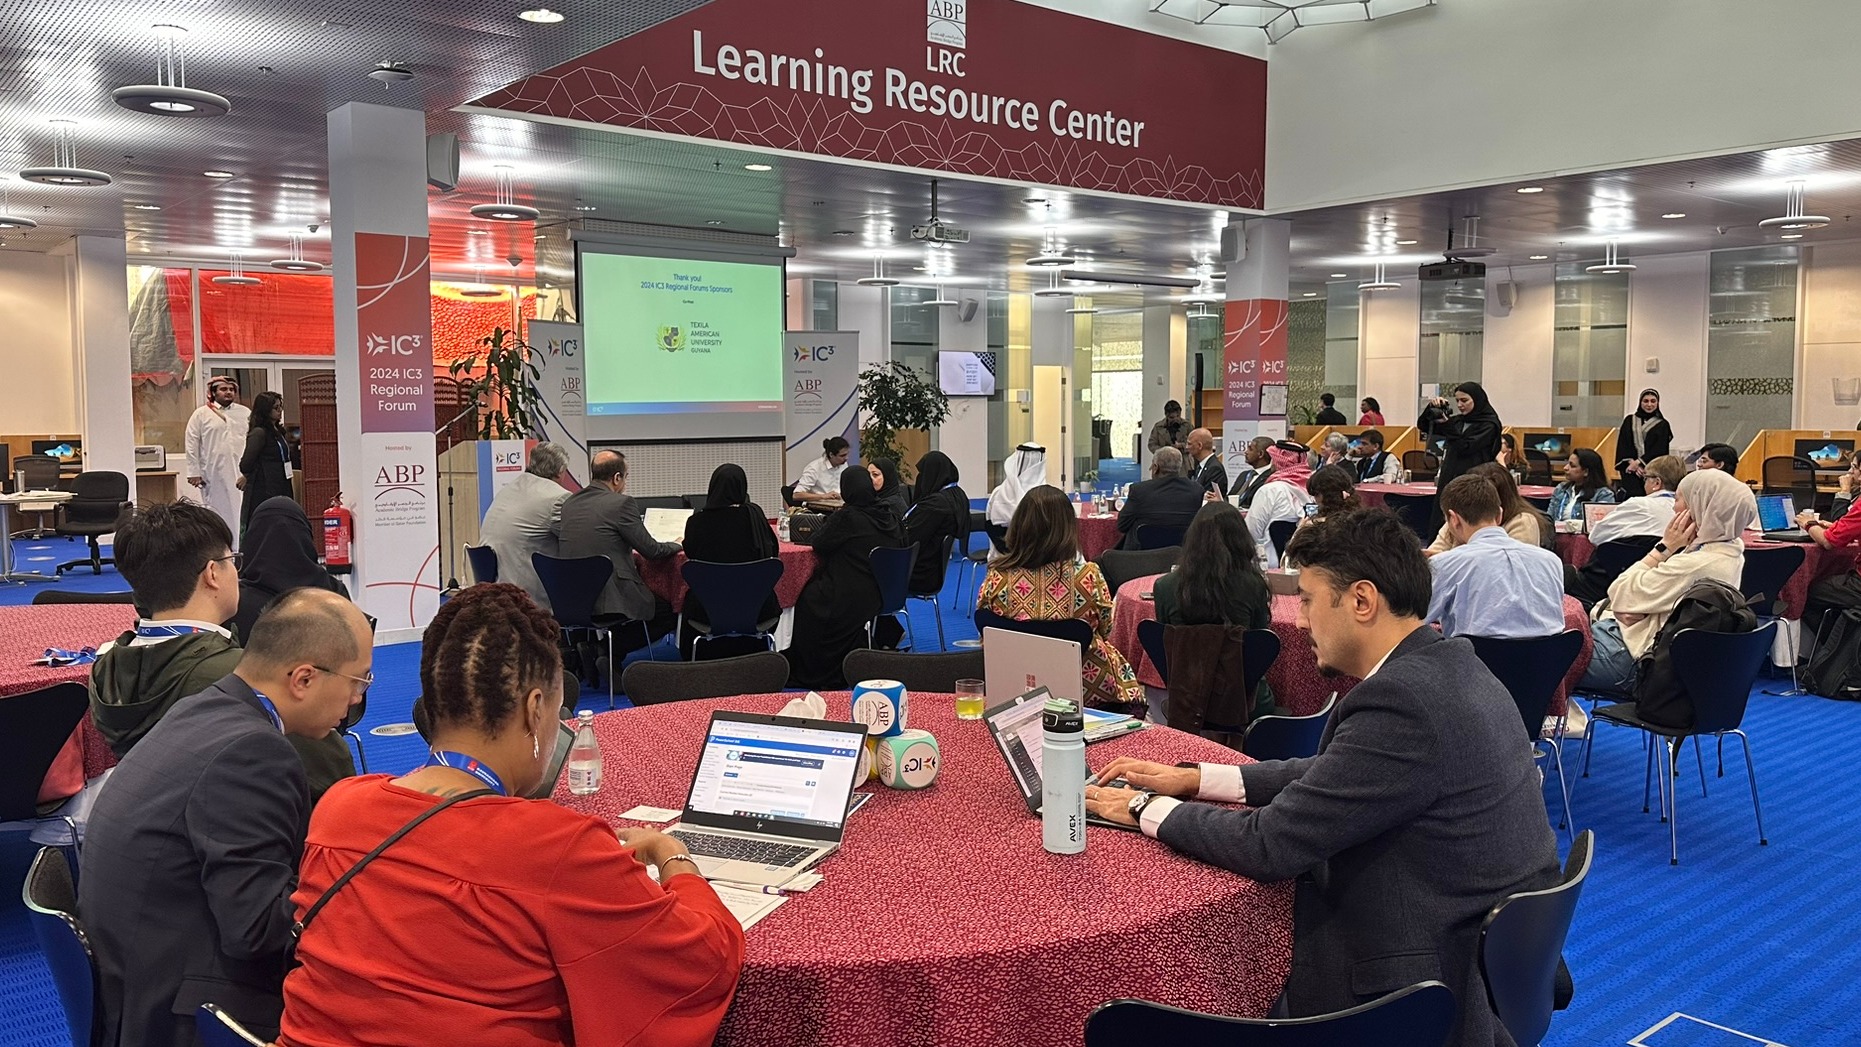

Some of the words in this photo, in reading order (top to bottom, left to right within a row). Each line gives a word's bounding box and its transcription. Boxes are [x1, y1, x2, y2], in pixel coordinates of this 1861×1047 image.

[930, 0, 964, 20] ABP
[926, 46, 966, 77] LRC
[692, 29, 873, 114] Learning
[884, 67, 1040, 132] Resource
[1048, 99, 1145, 148] Center
[673, 273, 689, 281] Thank
[640, 281, 654, 289] 2024
[655, 282, 665, 290] IC3
[665, 283, 689, 292] Regional
[689, 284, 709, 292] Forums
[709, 285, 733, 294] Sponsors
[690, 330, 720, 338] AMERICAN
[690, 339, 722, 347] UNIVERSITY
[370, 368, 400, 379] 2024
[403, 368, 423, 380] IC3
[561, 377, 581, 390] ABP
[794, 379, 822, 391] ABP
[1228, 380, 1244, 389] 2024
[1244, 381, 1256, 389] IC3
[370, 384, 423, 398] Regional
[1228, 390, 1256, 400] Regional
[378, 400, 417, 411] Forum
[1231, 400, 1252, 409] Forum
[375, 464, 425, 484] ABP
[879, 701, 889, 726] ABP
[1069, 814, 1077, 842] AVEX
